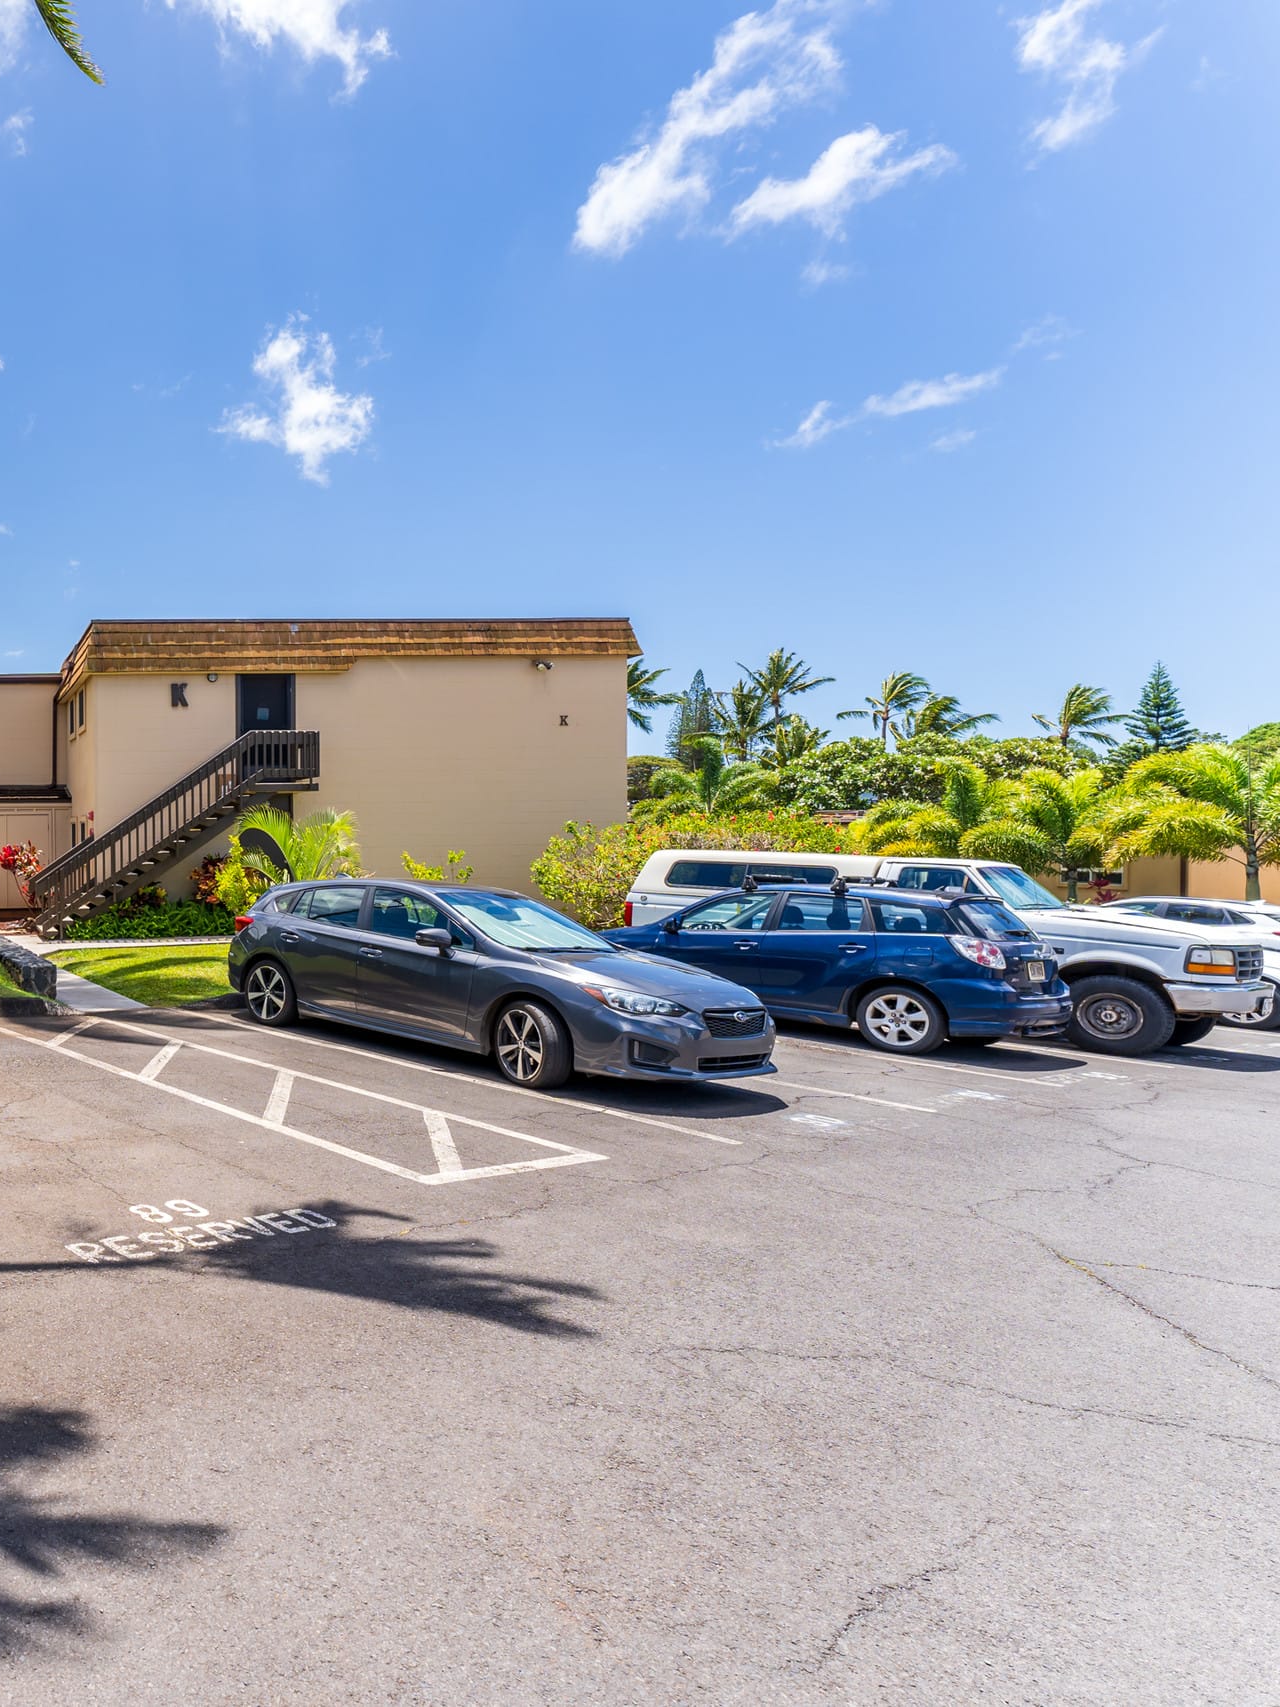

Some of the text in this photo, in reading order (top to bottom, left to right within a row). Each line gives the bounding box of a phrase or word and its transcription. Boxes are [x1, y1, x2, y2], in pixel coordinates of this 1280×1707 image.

[170, 683, 189, 708] K
[559, 715, 569, 727] K
[128, 1199, 210, 1224] 89
[64, 1208, 338, 1264] RESERVED
